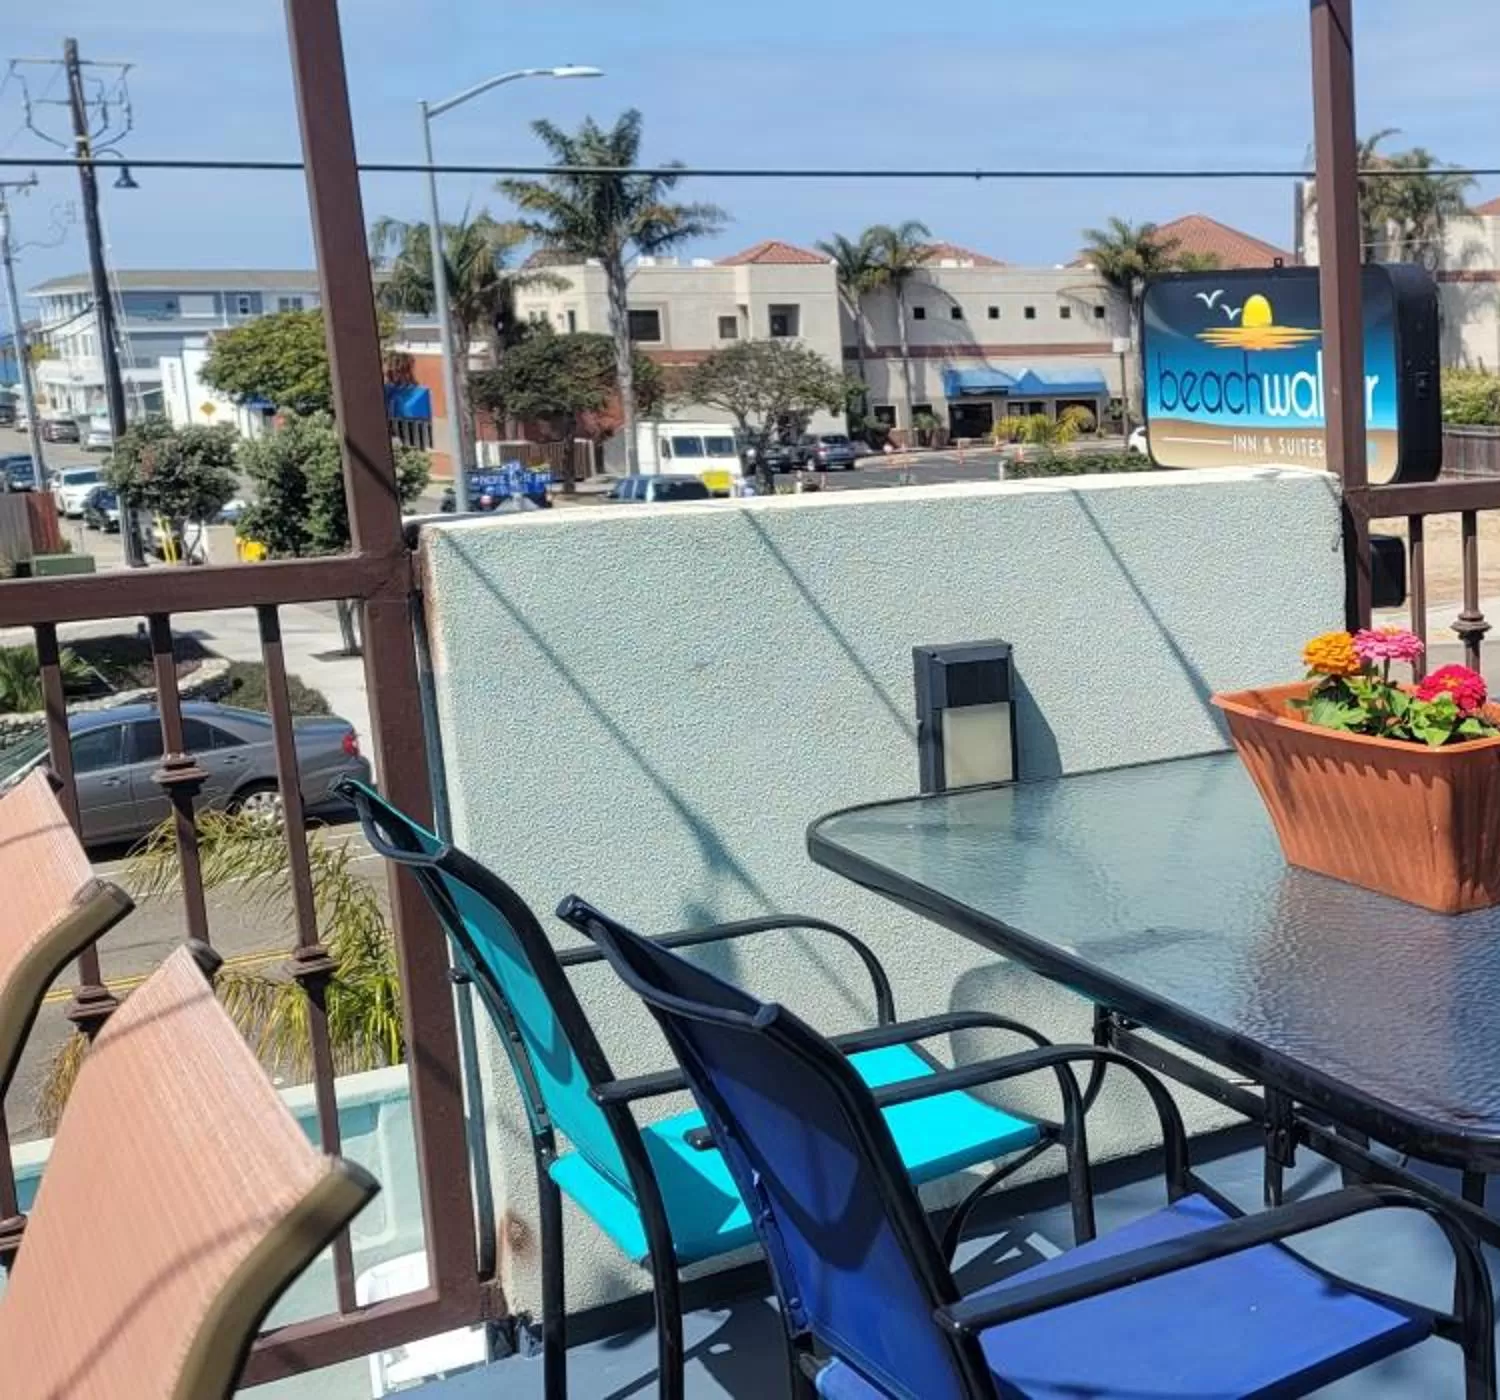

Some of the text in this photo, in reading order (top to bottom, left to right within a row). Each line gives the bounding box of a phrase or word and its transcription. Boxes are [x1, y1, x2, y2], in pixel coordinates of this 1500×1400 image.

[1157, 350, 1380, 421] beachwalr
[1232, 433, 1325, 457] INN & SUITES
